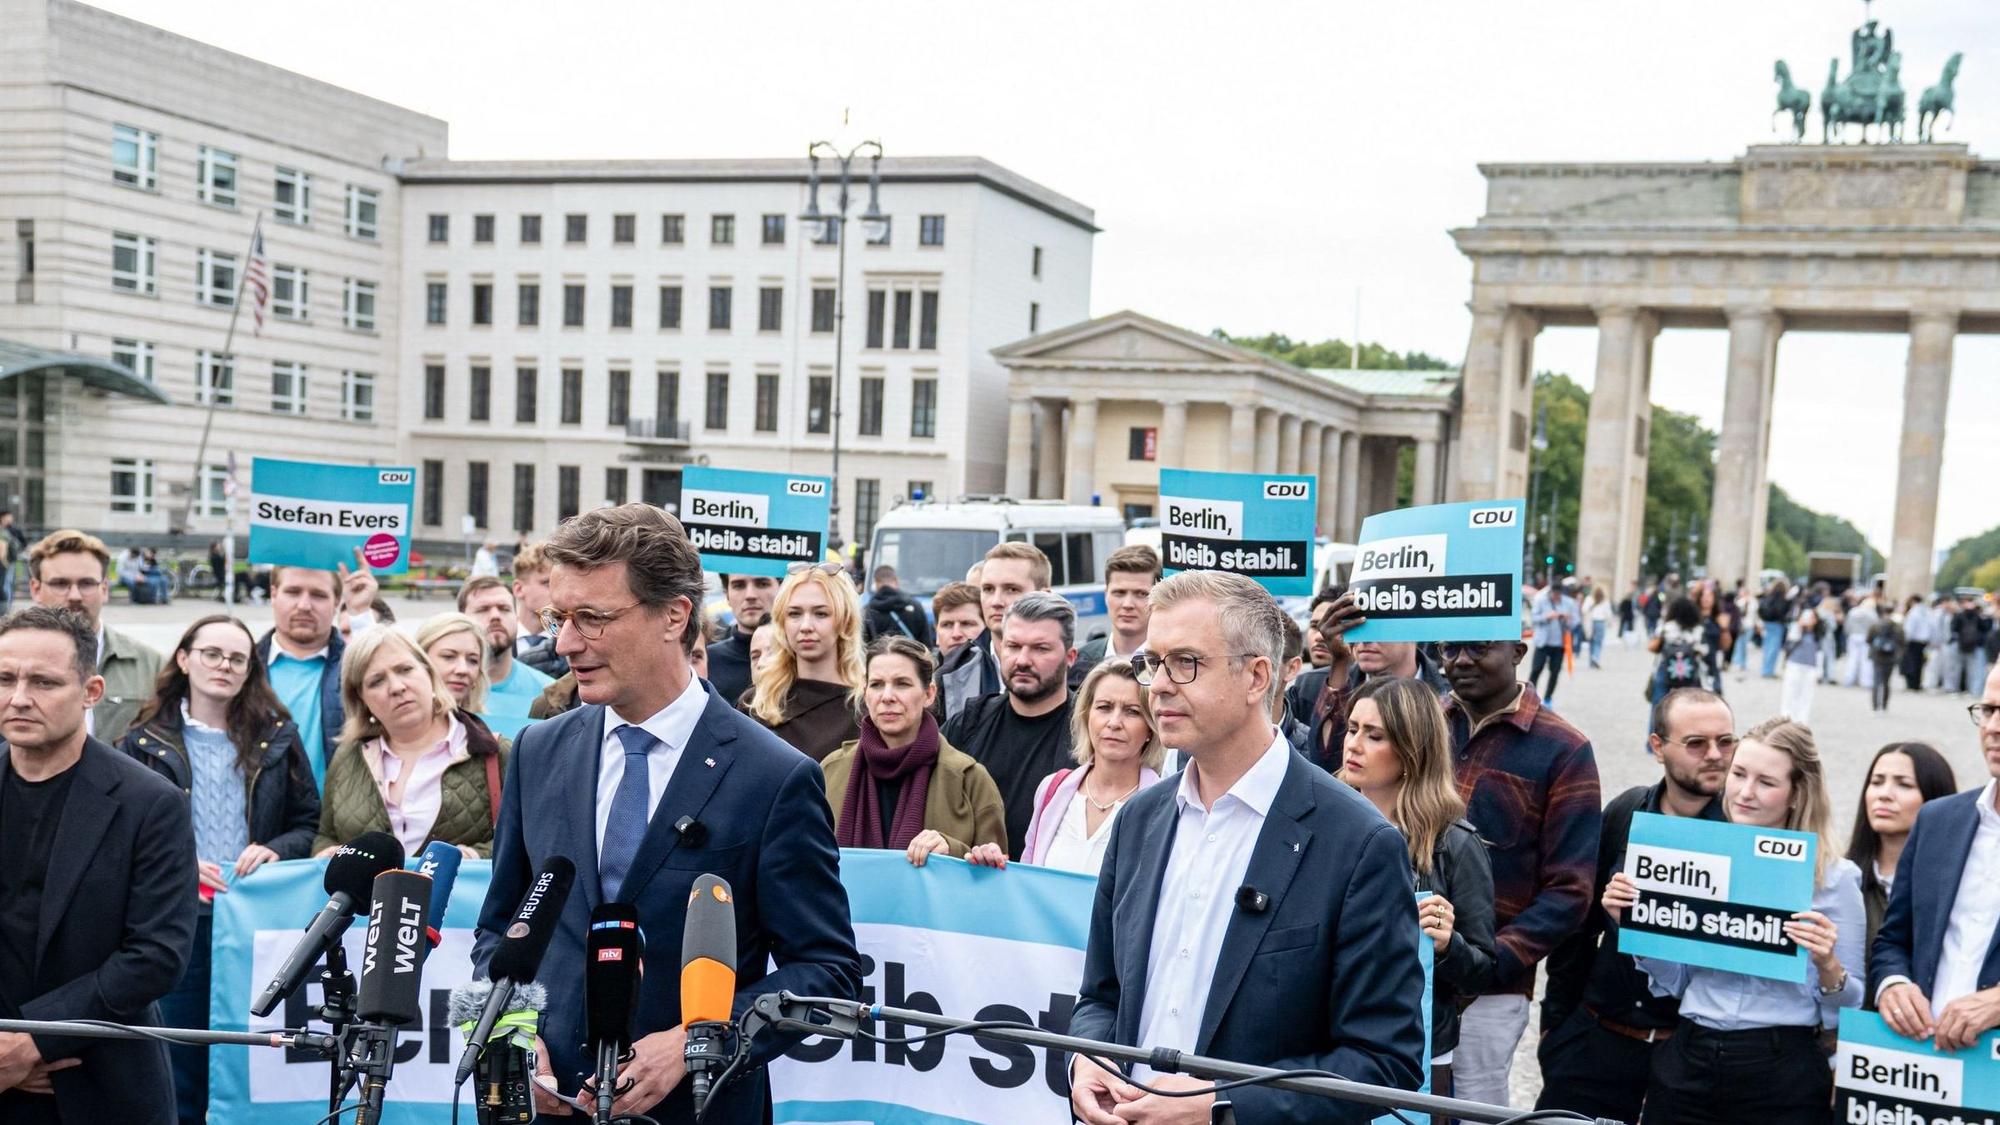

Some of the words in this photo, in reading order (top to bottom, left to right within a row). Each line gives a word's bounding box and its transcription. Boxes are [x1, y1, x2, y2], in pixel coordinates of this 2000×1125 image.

[381, 473, 409, 482] CDU
[790, 482, 822, 494] CDU
[1267, 484, 1306, 496] CDU
[258, 502, 332, 526] Stefan
[339, 510, 399, 528] Evers
[692, 498, 759, 524] Berlin,
[1169, 505, 1232, 536] Berlin,
[1472, 510, 1513, 525] CDU
[690, 528, 744, 551] bleib
[747, 535, 813, 556] stabil.
[1169, 541, 1216, 568] bleib
[1220, 547, 1298, 570] stabil.
[1360, 544, 1434, 572] Berlin,
[1353, 584, 1417, 611] bleib
[1421, 581, 1503, 609] stabil.
[1758, 840, 1802, 857] CDU
[1635, 855, 1717, 896] Berlin,
[519, 872, 554, 919] REUTERS
[1631, 897, 1698, 931] bleib
[1701, 911, 1788, 946] stabil.
[602, 950, 619, 958] ntv
[685, 1043, 707, 1055] ZDF
[1851, 1054, 1947, 1099] Berlin,
